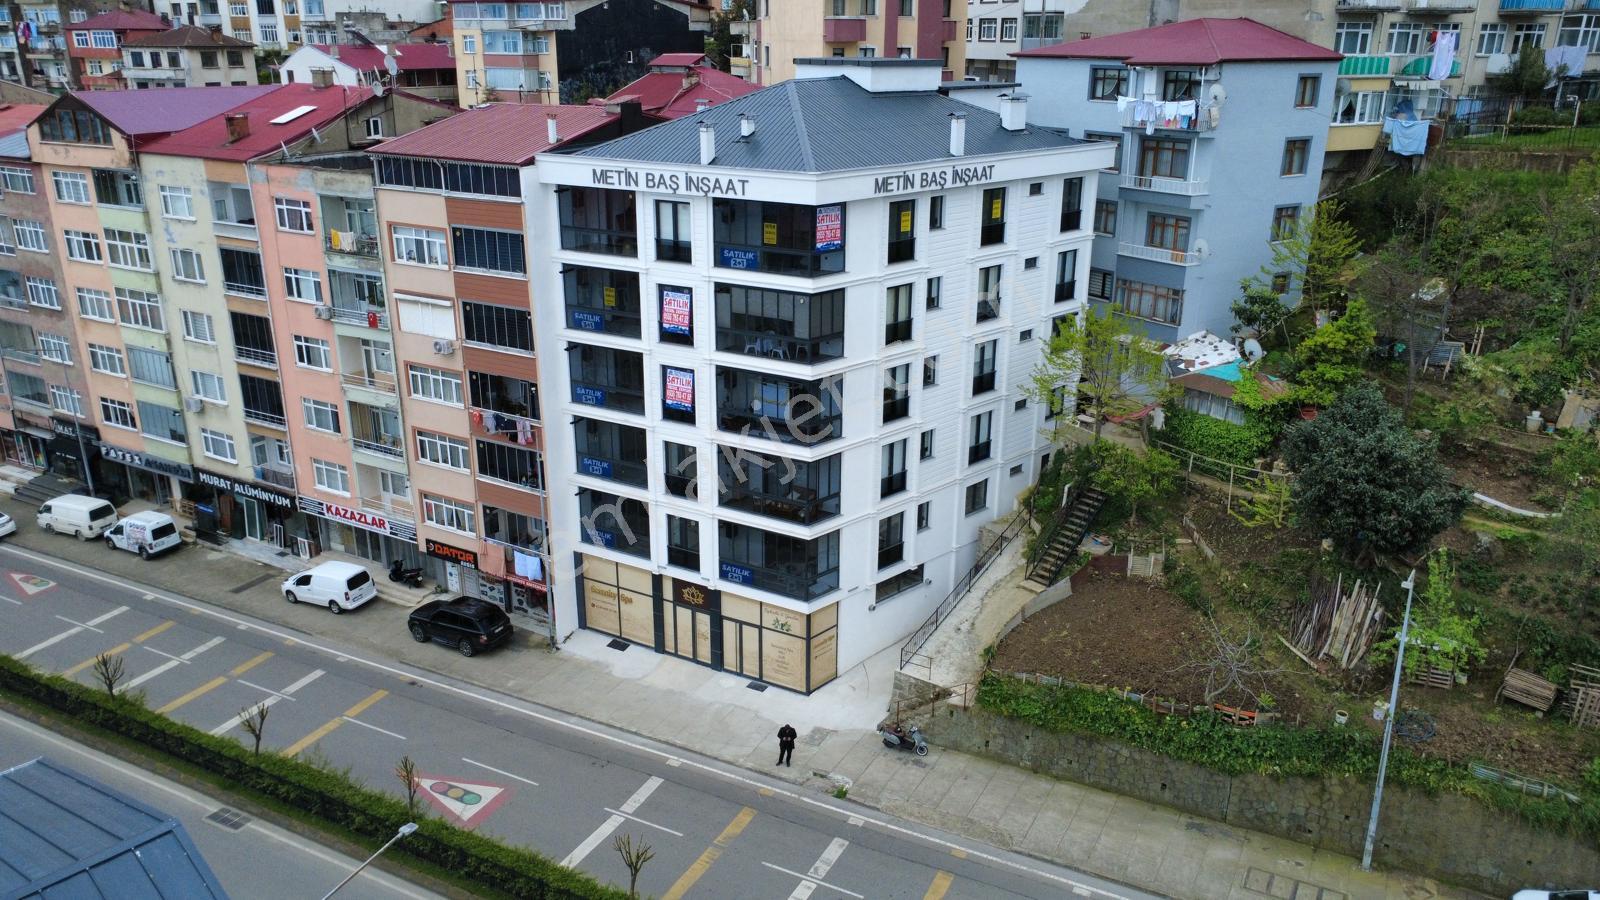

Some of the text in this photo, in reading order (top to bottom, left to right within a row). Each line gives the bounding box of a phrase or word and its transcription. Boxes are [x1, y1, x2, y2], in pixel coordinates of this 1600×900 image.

[592, 168, 749, 197] METİN BAŞ İNŞAAT
[874, 165, 995, 194] METİN BAŞ İNŞAAT
[817, 213, 840, 225] SATILIK
[723, 249, 756, 260] SATILIK
[664, 298, 689, 310] SATILIK
[574, 312, 601, 323] SATILIK
[667, 375, 692, 388] SATILIK
[583, 457, 609, 469] SATILIK
[199, 472, 232, 490] MURAT
[234, 483, 291, 508] ALÜMİNYUM
[325, 504, 387, 530] KAZAZLAR
[722, 563, 752, 577] SATILIK
